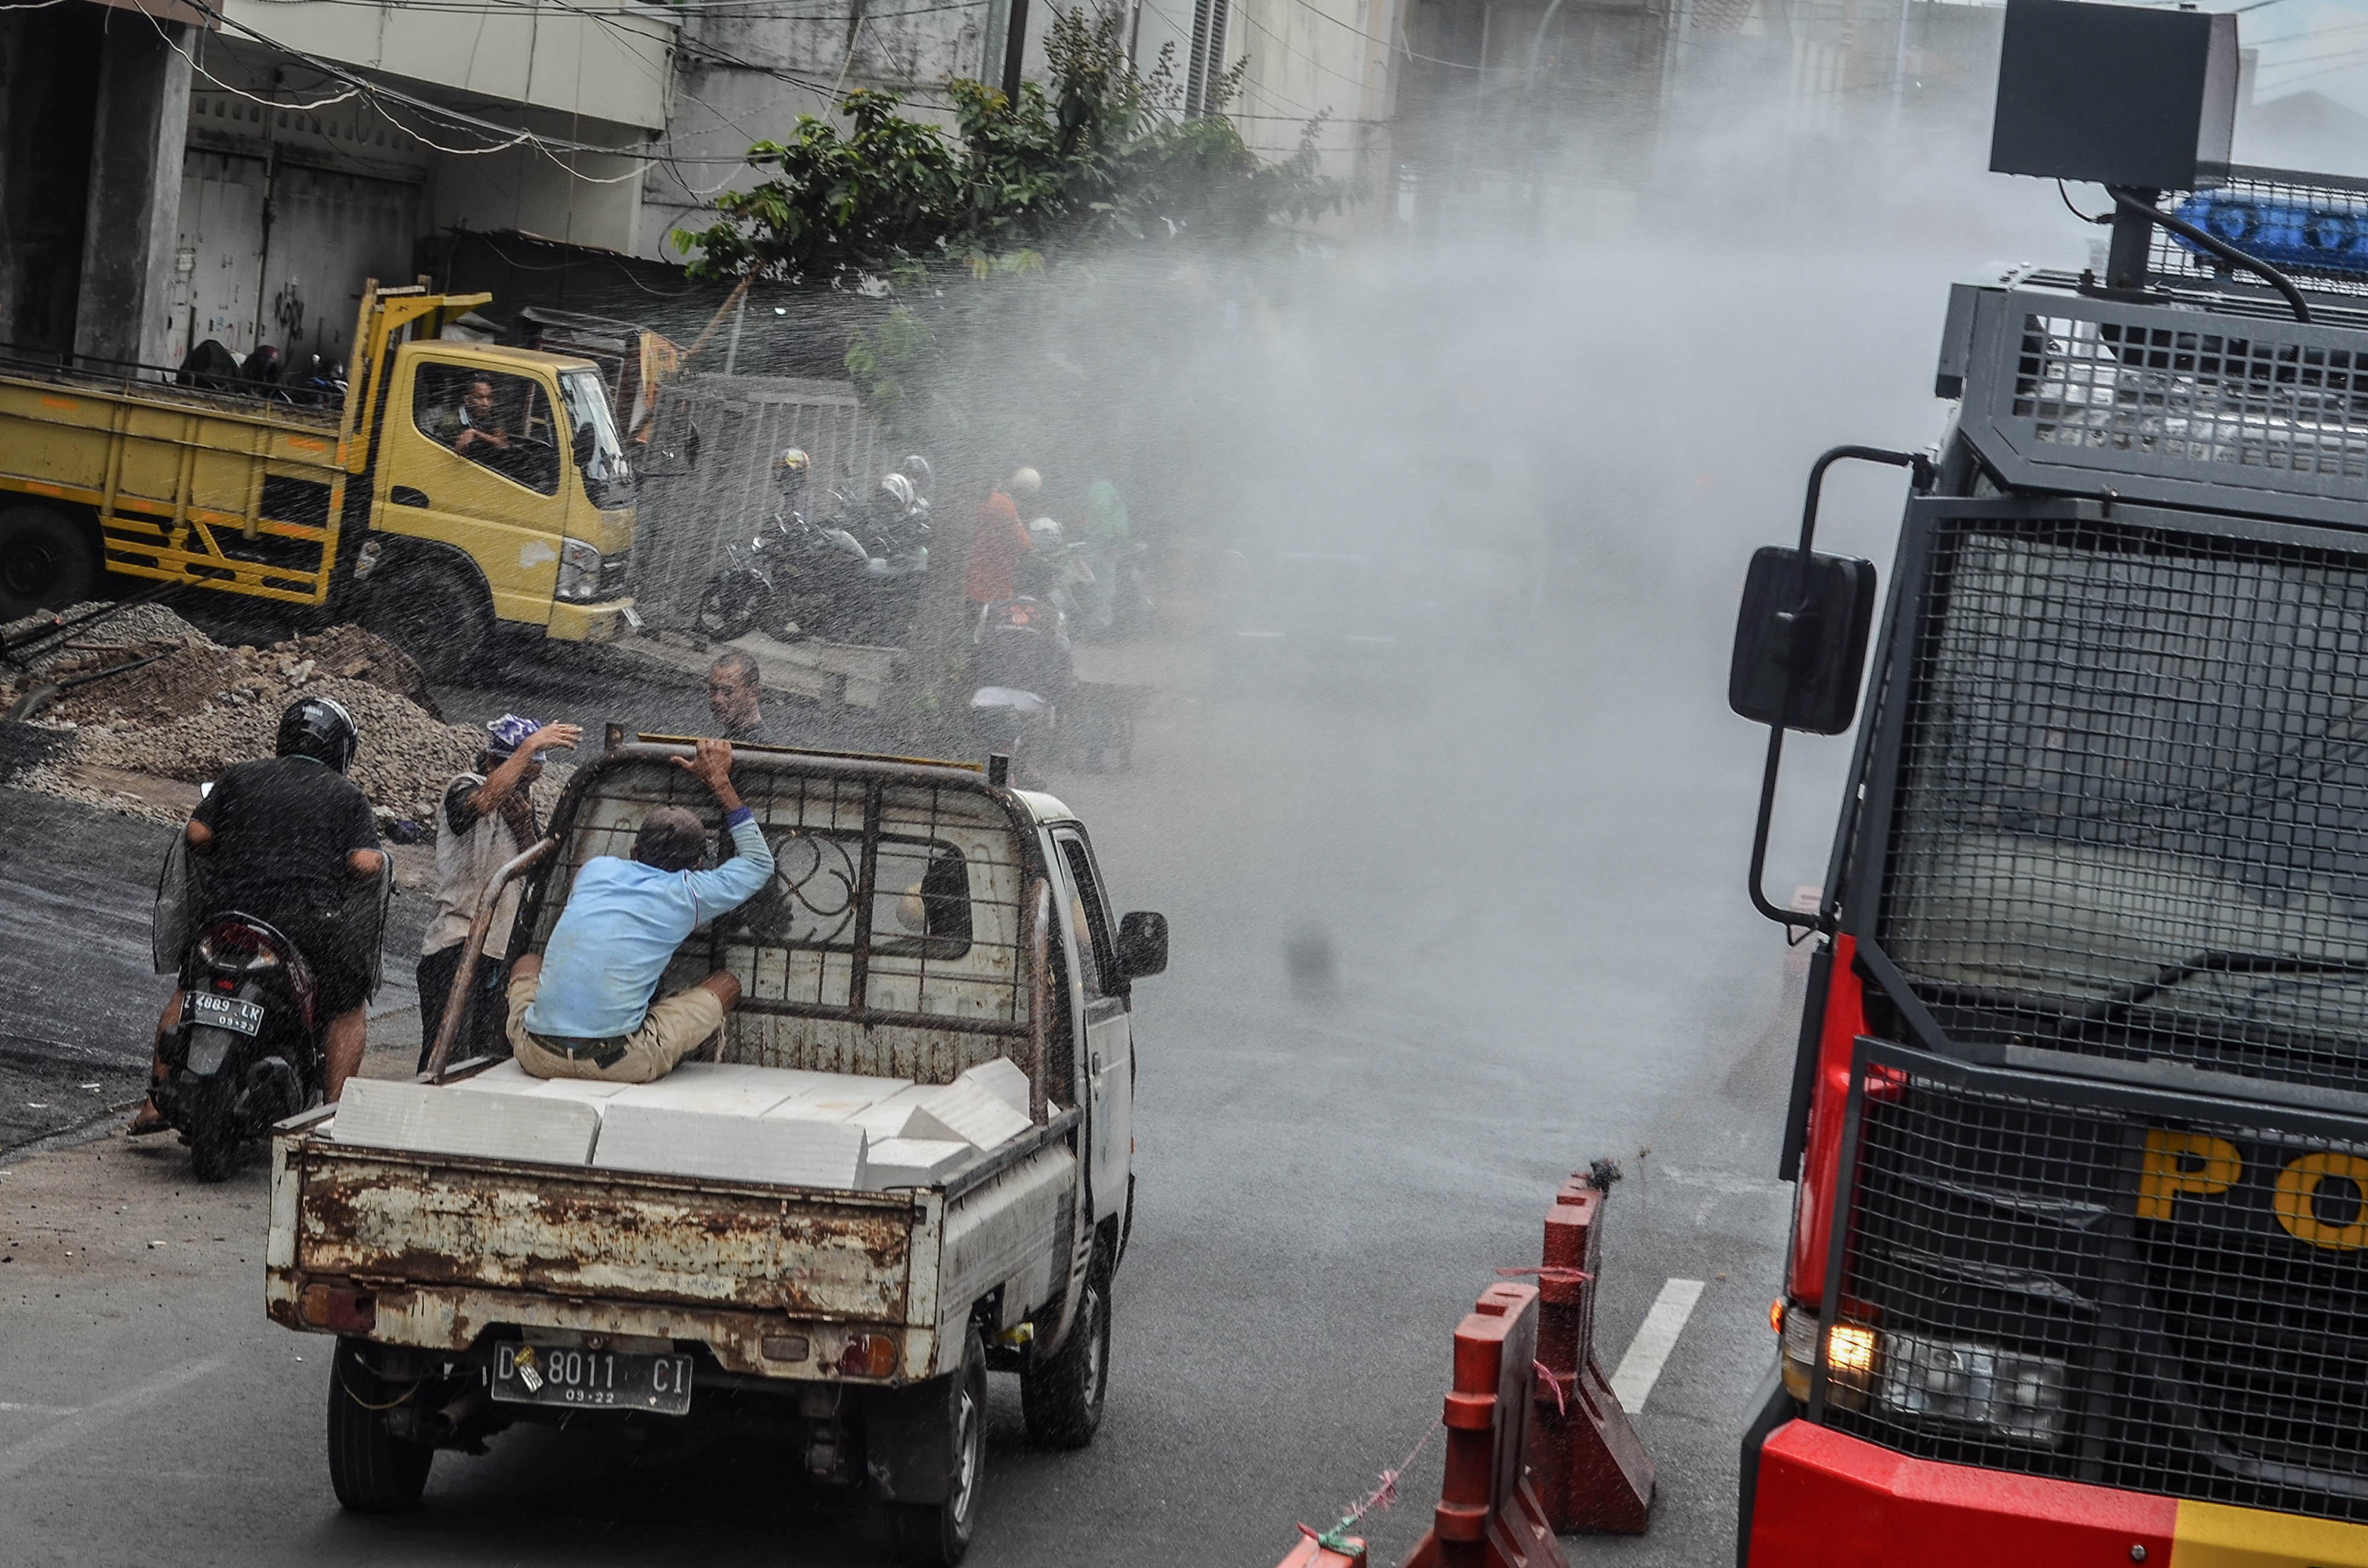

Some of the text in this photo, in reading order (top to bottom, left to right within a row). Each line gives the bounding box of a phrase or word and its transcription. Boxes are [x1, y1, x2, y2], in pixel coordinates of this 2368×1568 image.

[241, 1004, 260, 1022] LK
[2136, 1129, 2368, 1251] PO
[498, 1346, 684, 1393] D 8011 CI
